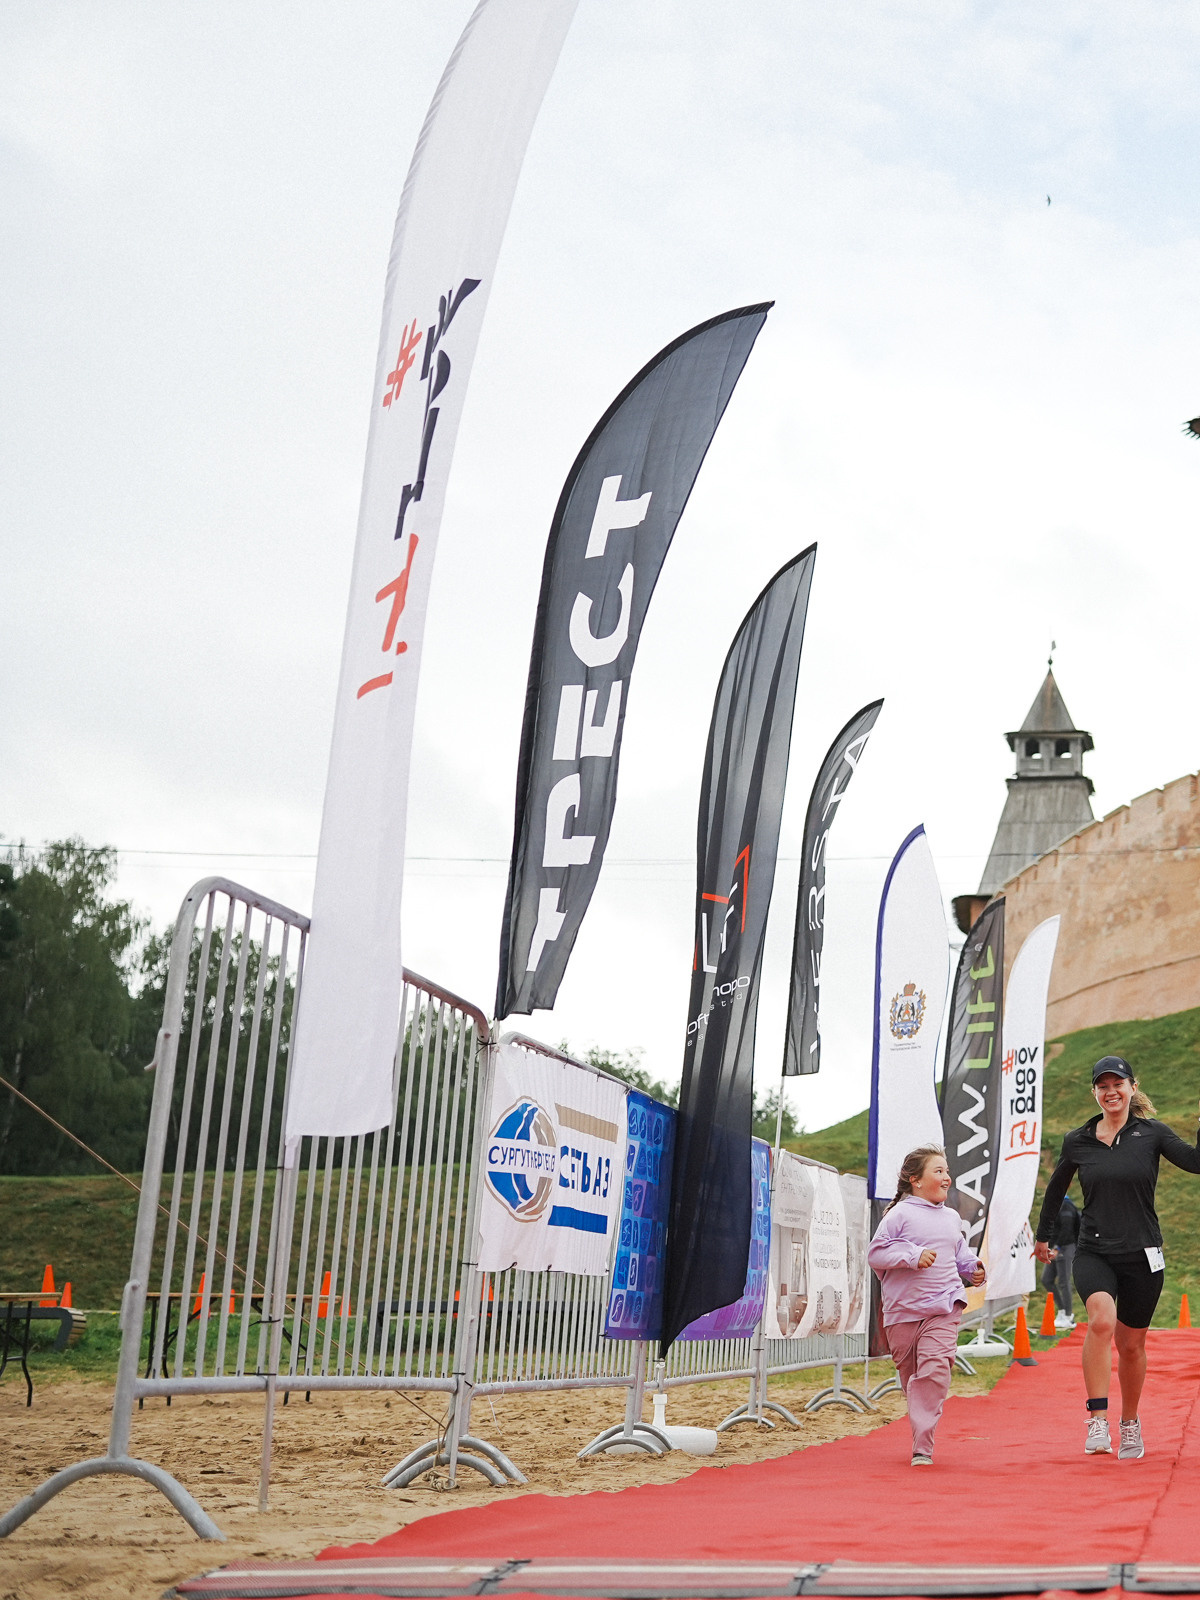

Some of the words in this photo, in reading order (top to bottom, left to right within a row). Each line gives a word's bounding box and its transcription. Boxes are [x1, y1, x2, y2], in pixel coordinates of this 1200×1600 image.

[687, 1013, 709, 1035] oft
[1015, 1067, 1036, 1094] go
[1010, 1085, 1036, 1116] rod
